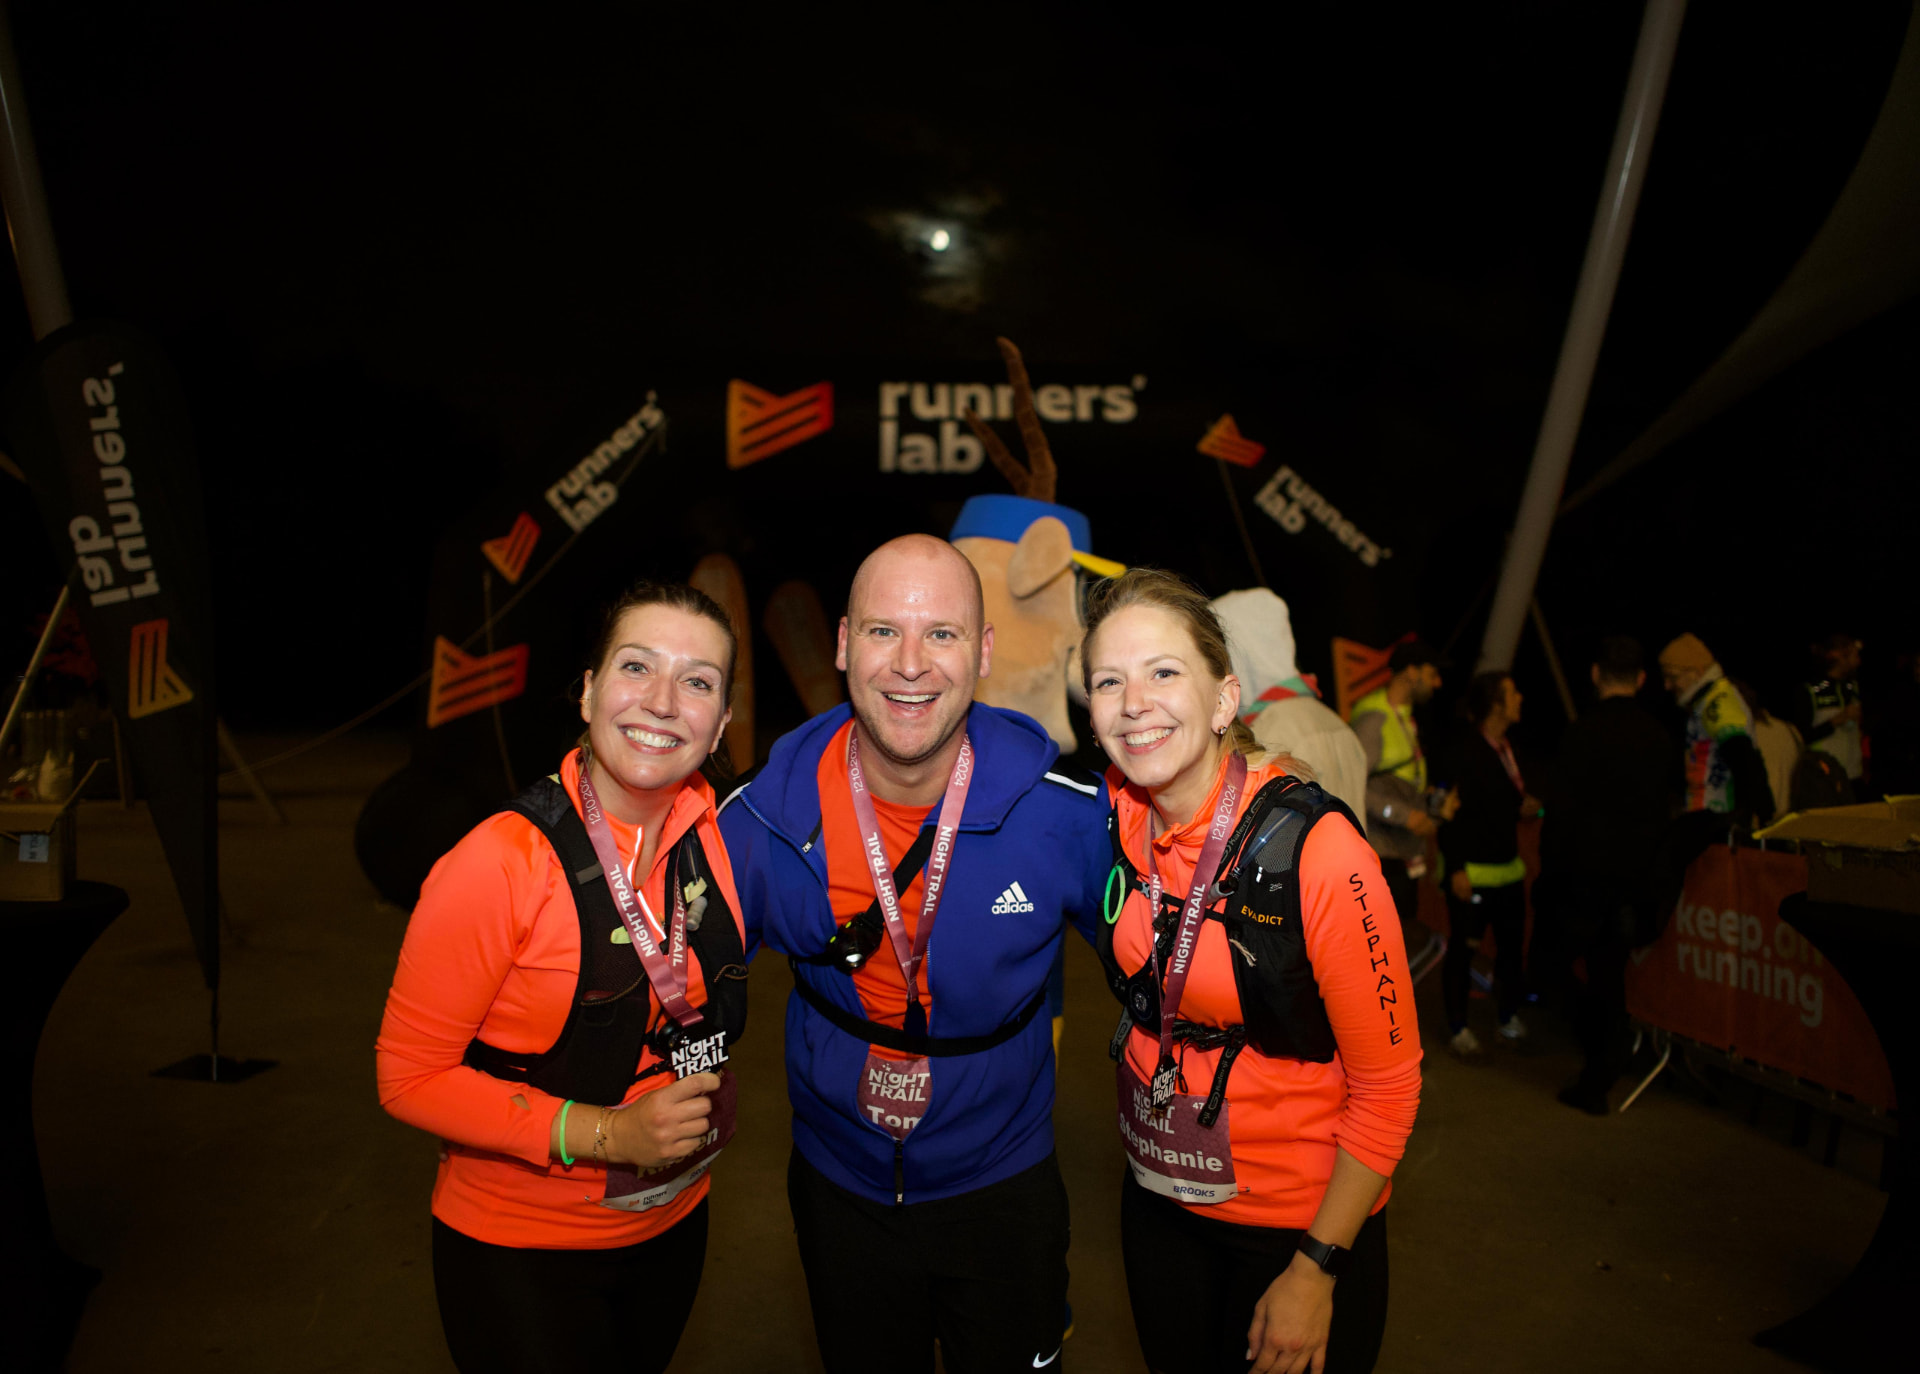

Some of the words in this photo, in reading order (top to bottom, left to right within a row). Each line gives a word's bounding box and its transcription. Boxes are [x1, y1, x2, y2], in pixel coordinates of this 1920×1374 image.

[878, 419, 986, 475] lab
[560, 480, 619, 534] lab
[1252, 478, 1307, 535] lab
[1211, 784, 1237, 842] 12.10.2024
[867, 832, 888, 877] TRAIL
[931, 826, 953, 872] NIGHT
[609, 863, 634, 910] TRAIL
[876, 875, 899, 922] NIGHT
[923, 868, 943, 916] TRAIL
[991, 902, 1034, 915] adidas
[627, 908, 657, 958] NIGHT
[1173, 927, 1195, 975] NIGHT
[1184, 883, 1206, 929] TRAIL
[1240, 905, 1284, 926] EVADICT
[672, 923, 684, 967] TRAIL
[1349, 873, 1403, 1046] STEPHANIE
[1677, 942, 1824, 1028] running
[1119, 1112, 1224, 1172] Stephanie
[1173, 1185, 1216, 1198] BROOKS
